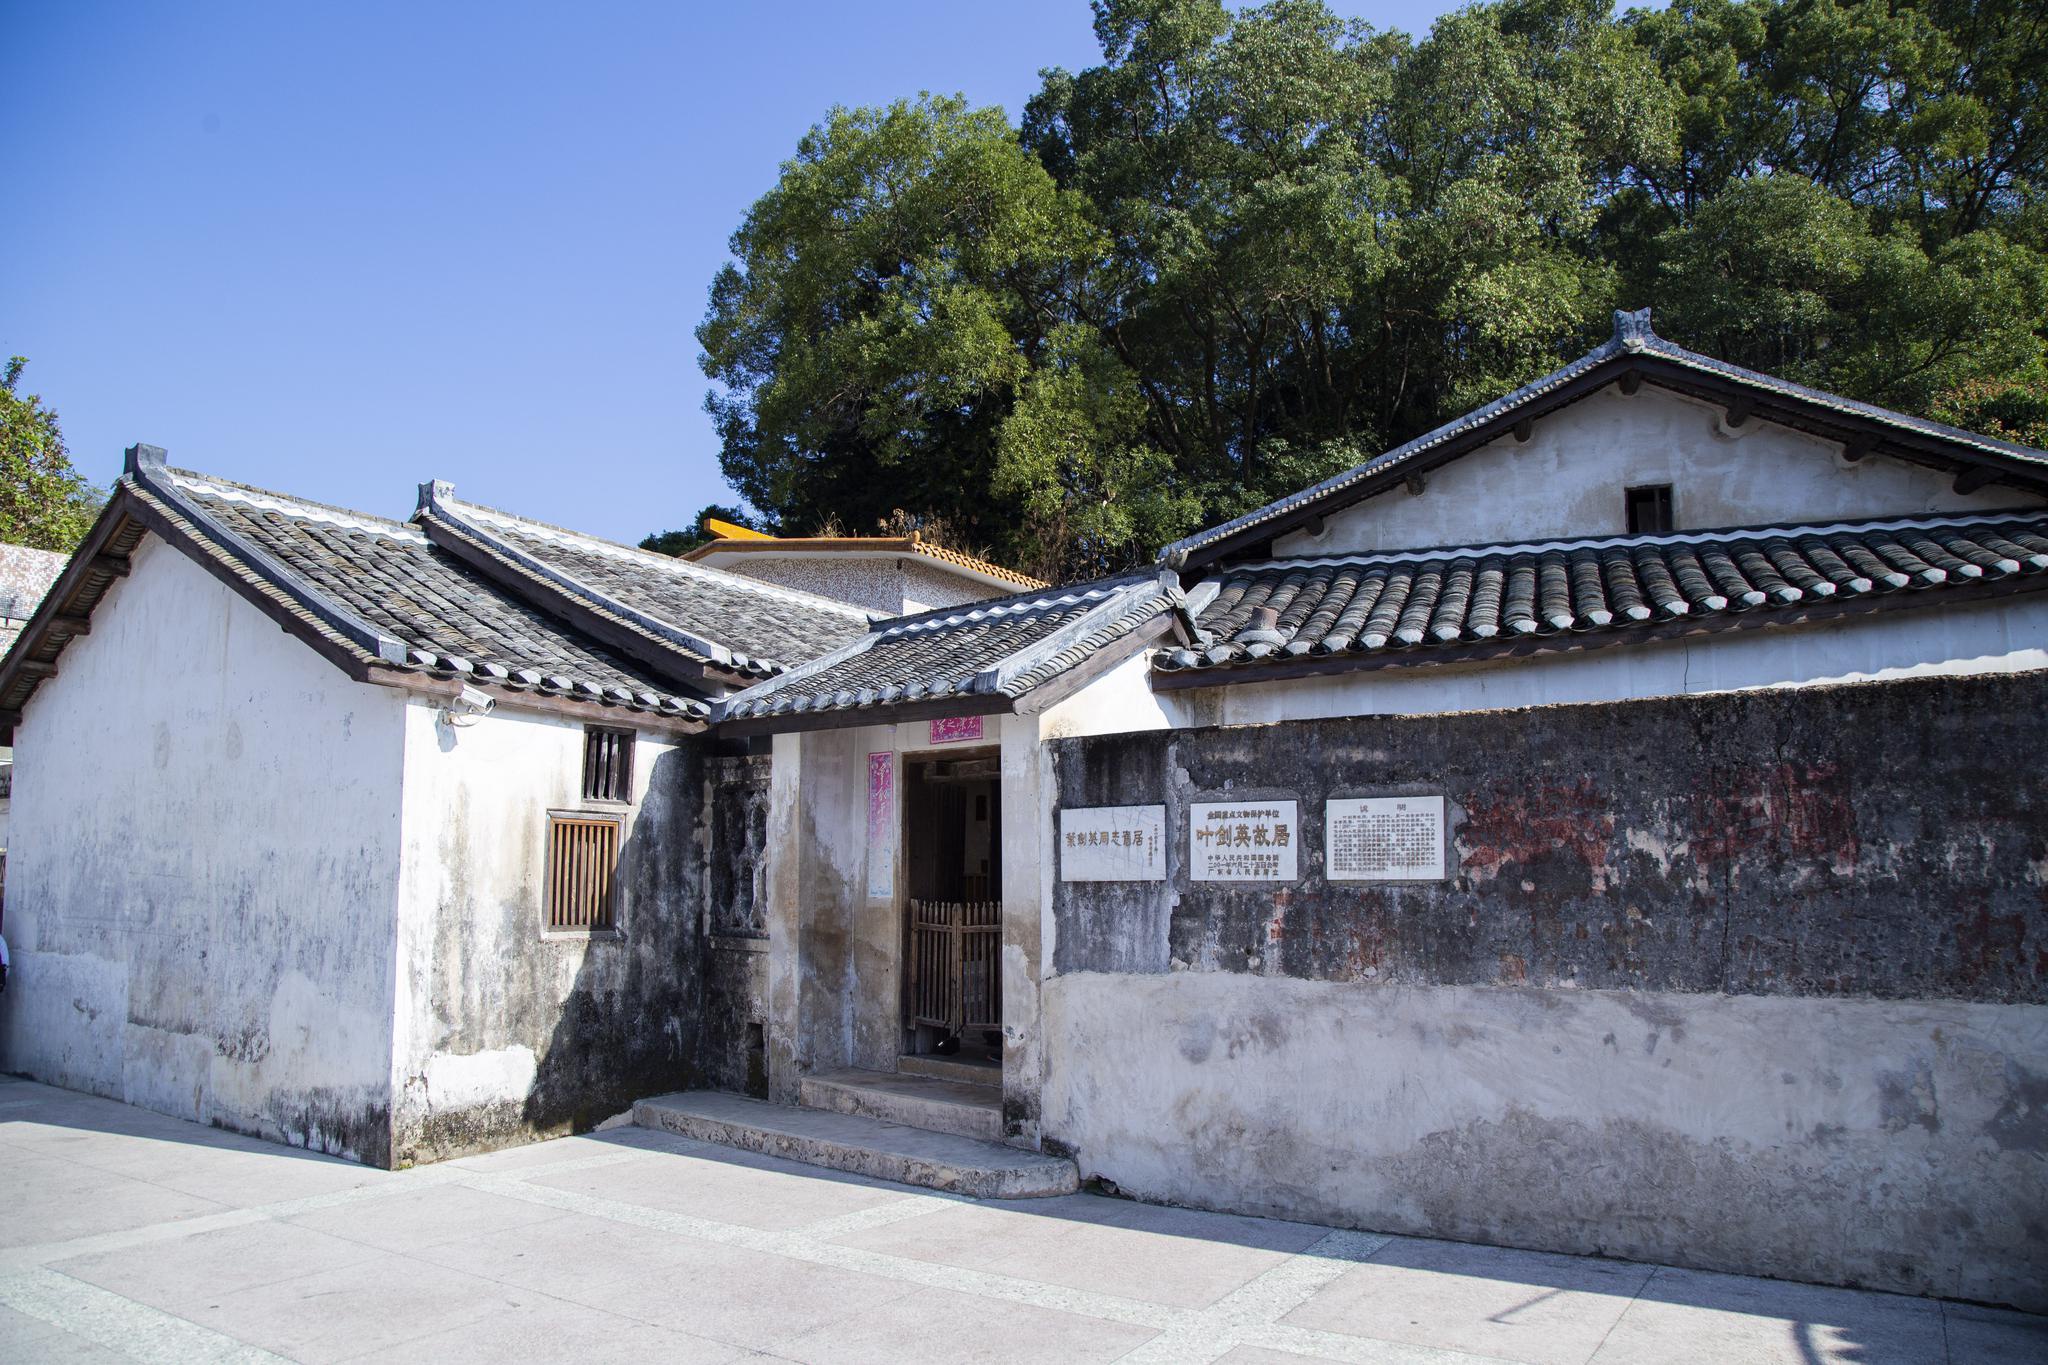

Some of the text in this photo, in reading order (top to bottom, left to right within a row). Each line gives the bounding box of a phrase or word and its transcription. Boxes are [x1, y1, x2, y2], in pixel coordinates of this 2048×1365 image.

[1207, 809, 1280, 820] 全国重点文物保护单位
[1196, 824, 1290, 848] 叶剑英故居
[1207, 854, 1280, 862] 中华人民共和国国务院
